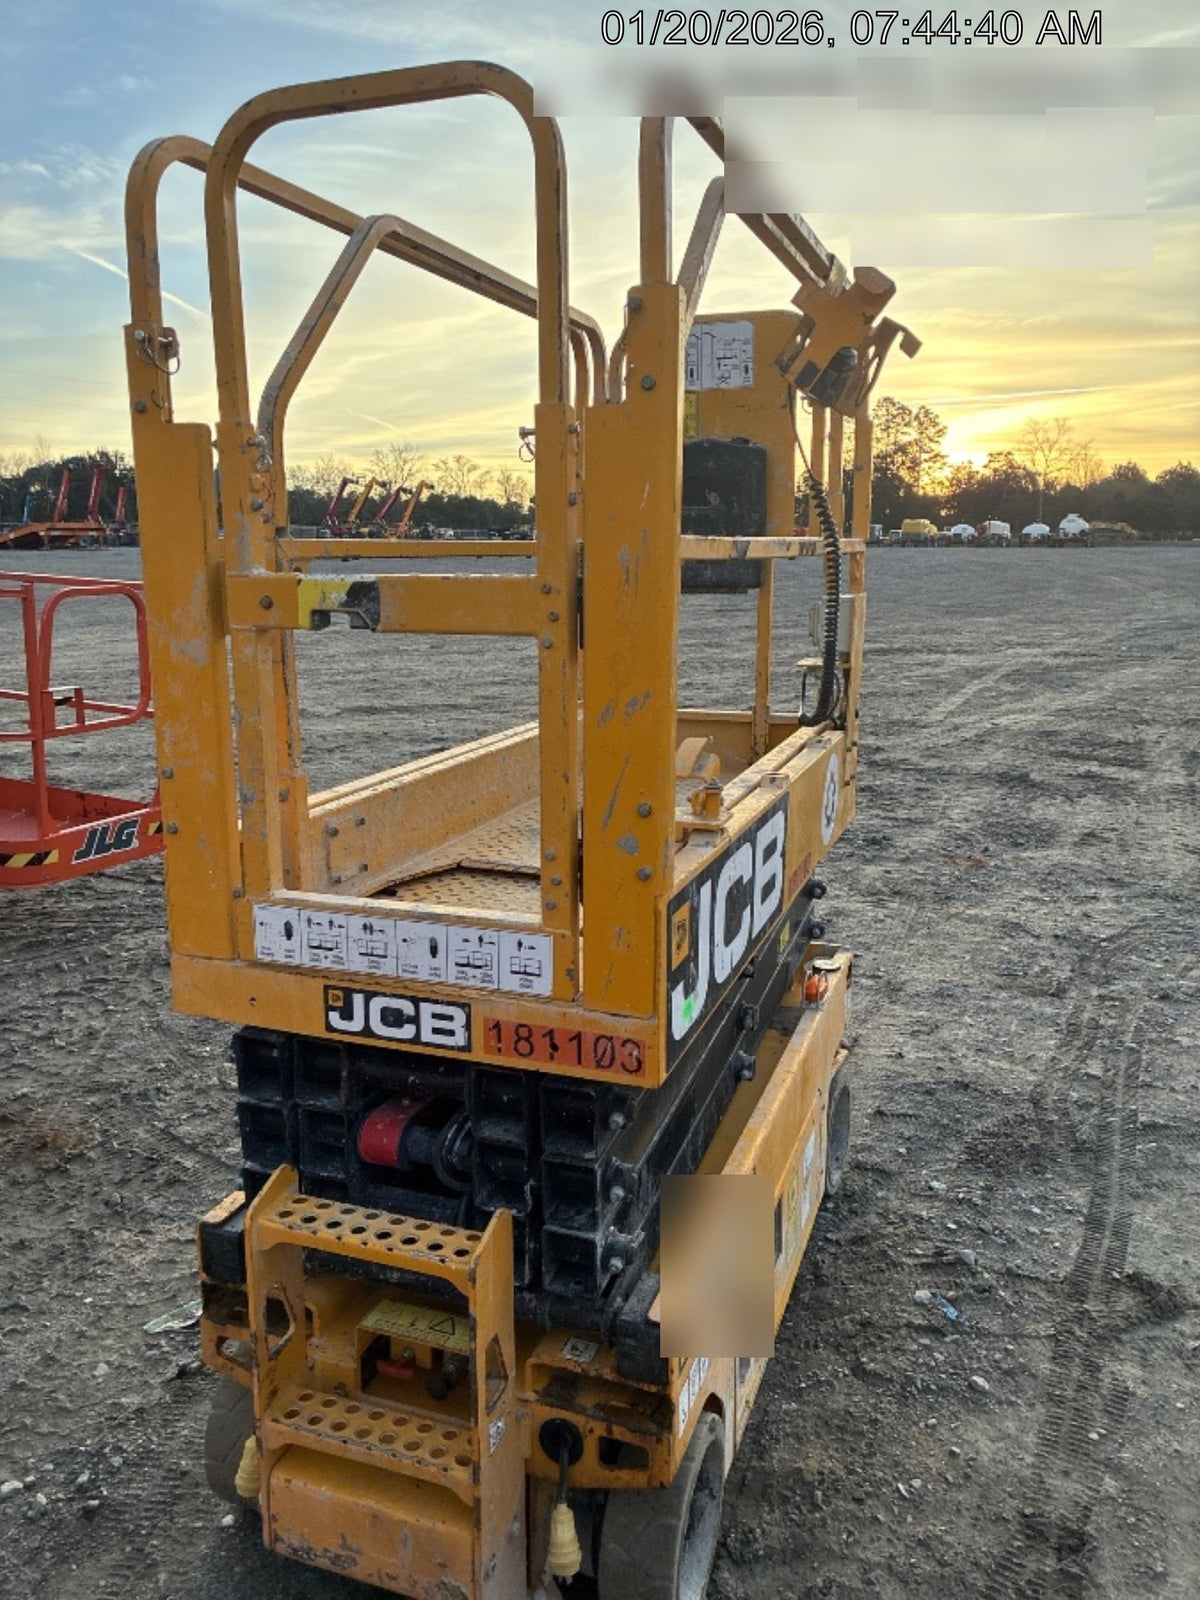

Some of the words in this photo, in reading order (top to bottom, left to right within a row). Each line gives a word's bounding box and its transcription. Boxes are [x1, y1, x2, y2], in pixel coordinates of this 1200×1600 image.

[72, 818, 140, 864] JLG
[671, 809, 785, 1041] JCB
[327, 992, 468, 1047] JCB
[488, 1019, 644, 1075] 181103
